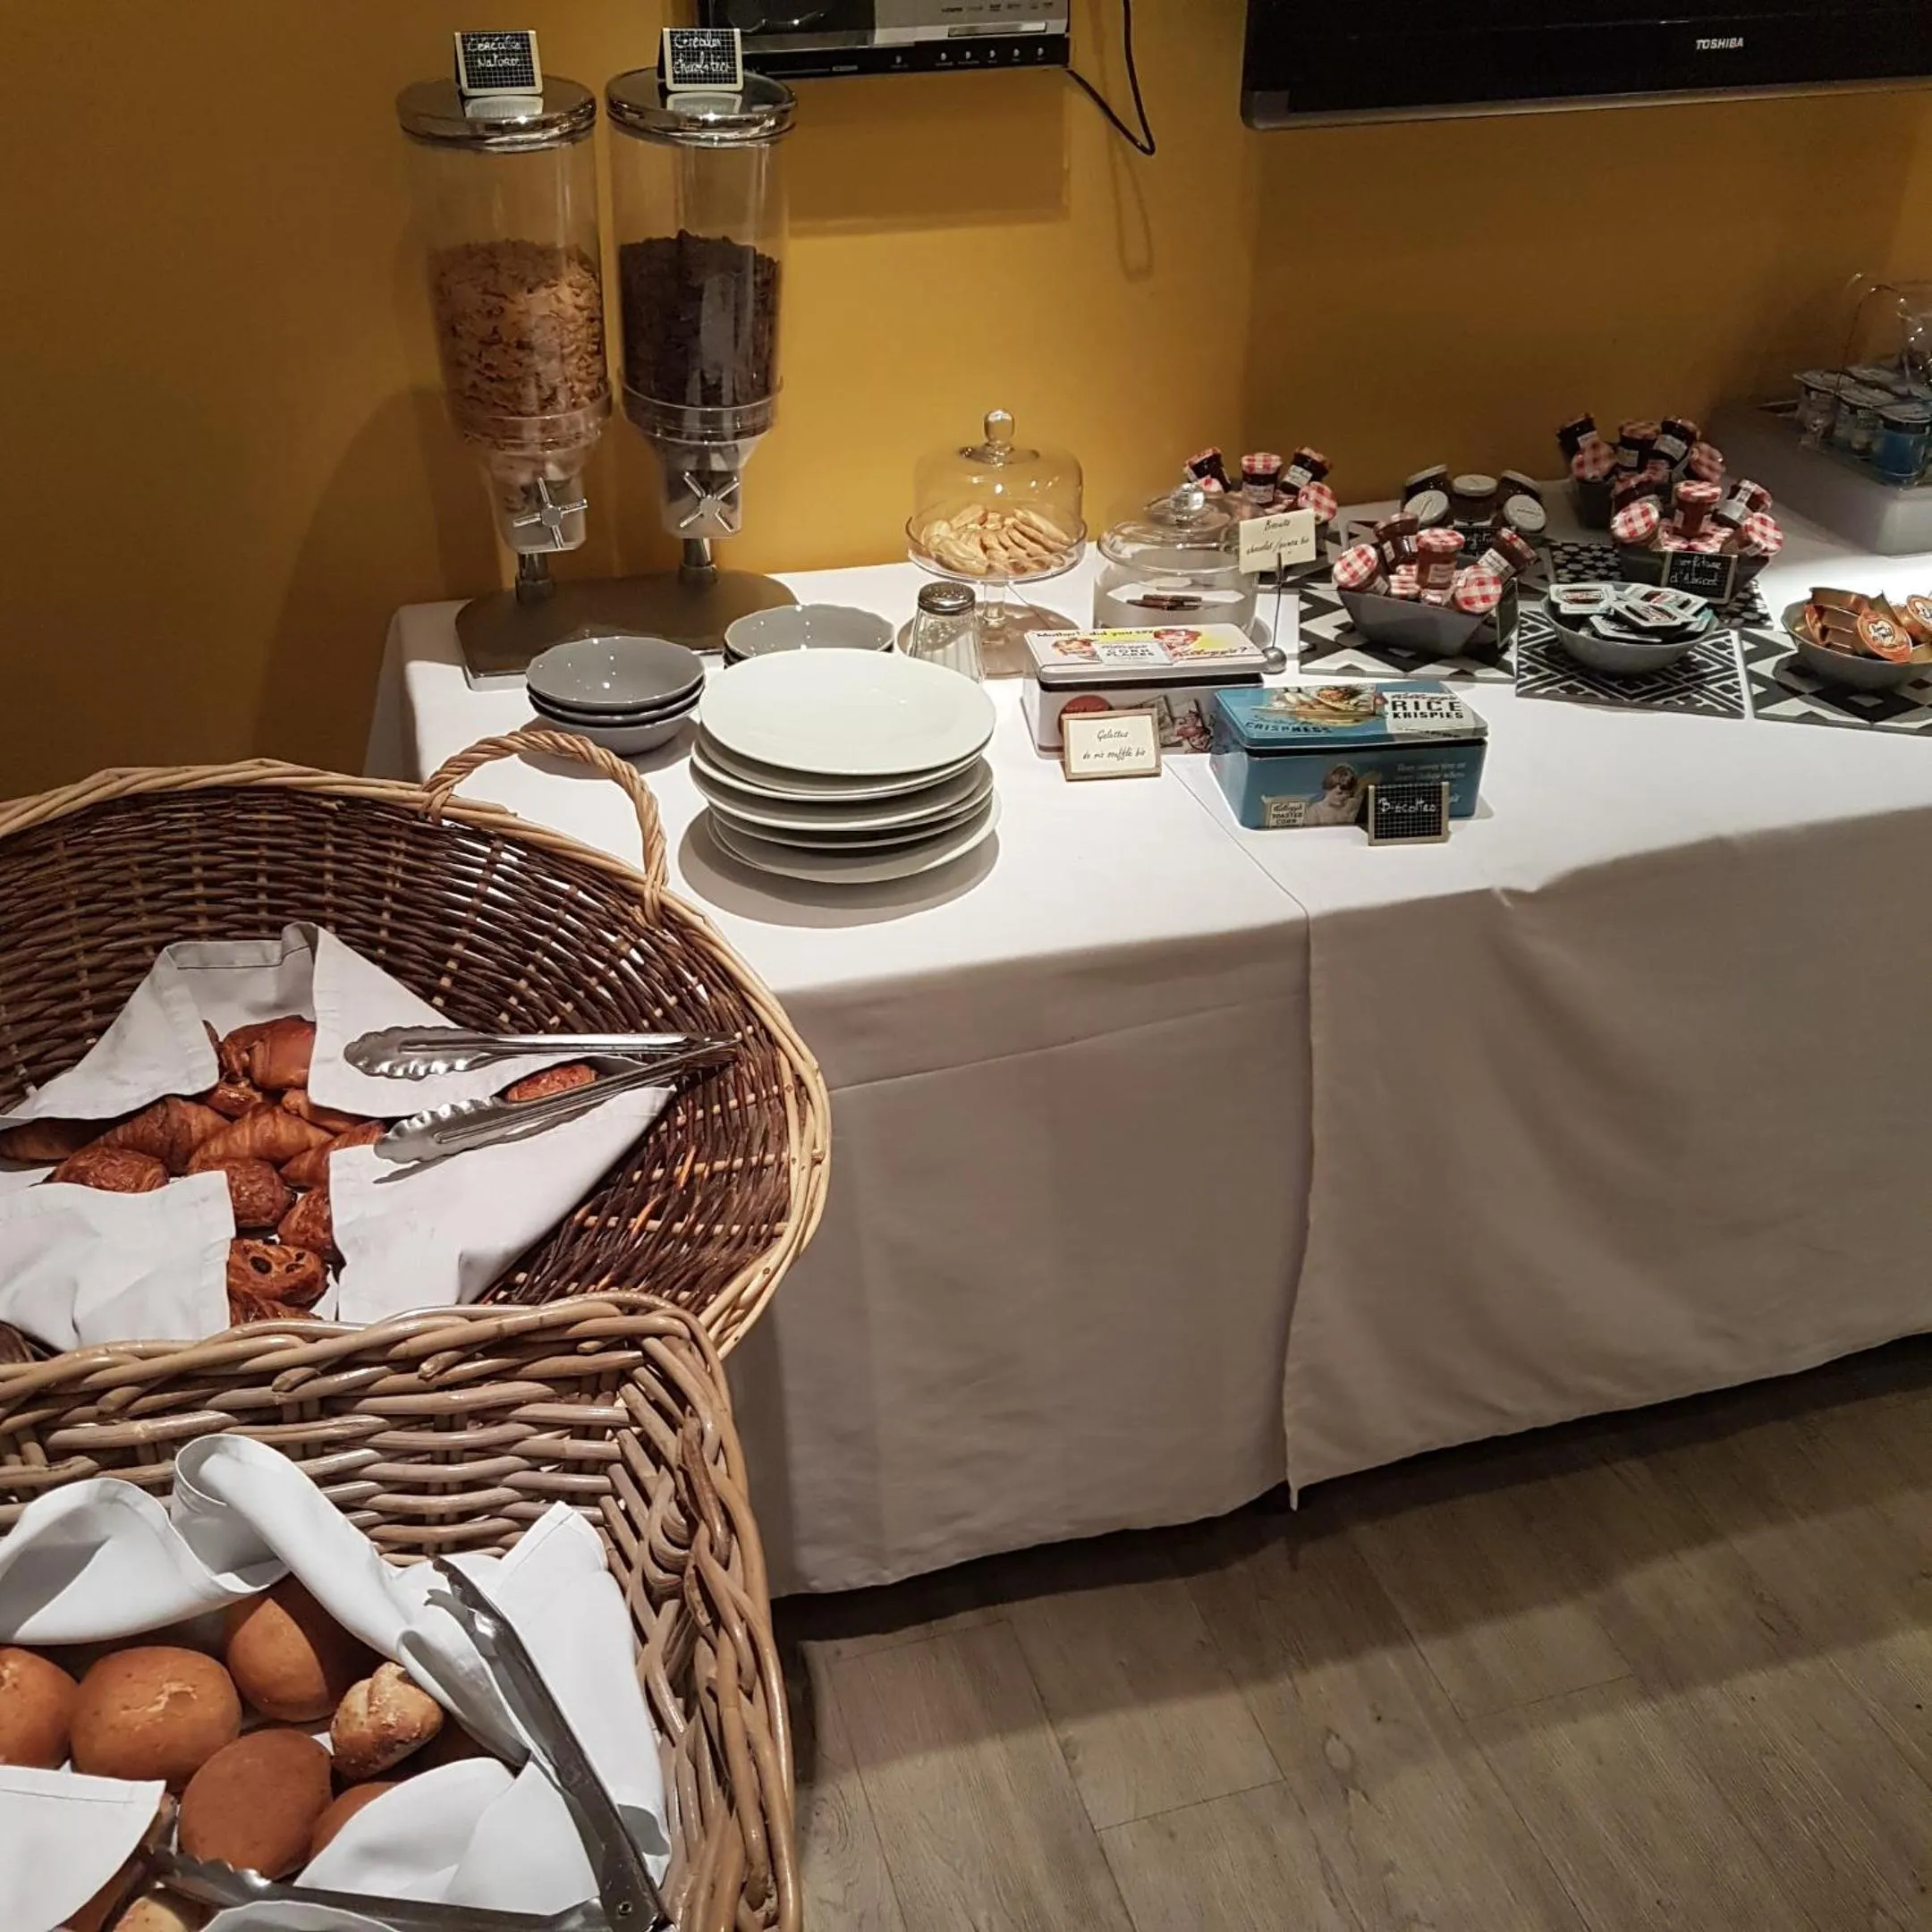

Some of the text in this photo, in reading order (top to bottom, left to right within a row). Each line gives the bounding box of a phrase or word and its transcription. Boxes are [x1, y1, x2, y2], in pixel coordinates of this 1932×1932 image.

[1696, 37, 1744, 50] TOSHIBA
[1392, 700, 1462, 712] RICE
[1393, 711, 1464, 719] KRISPIES
